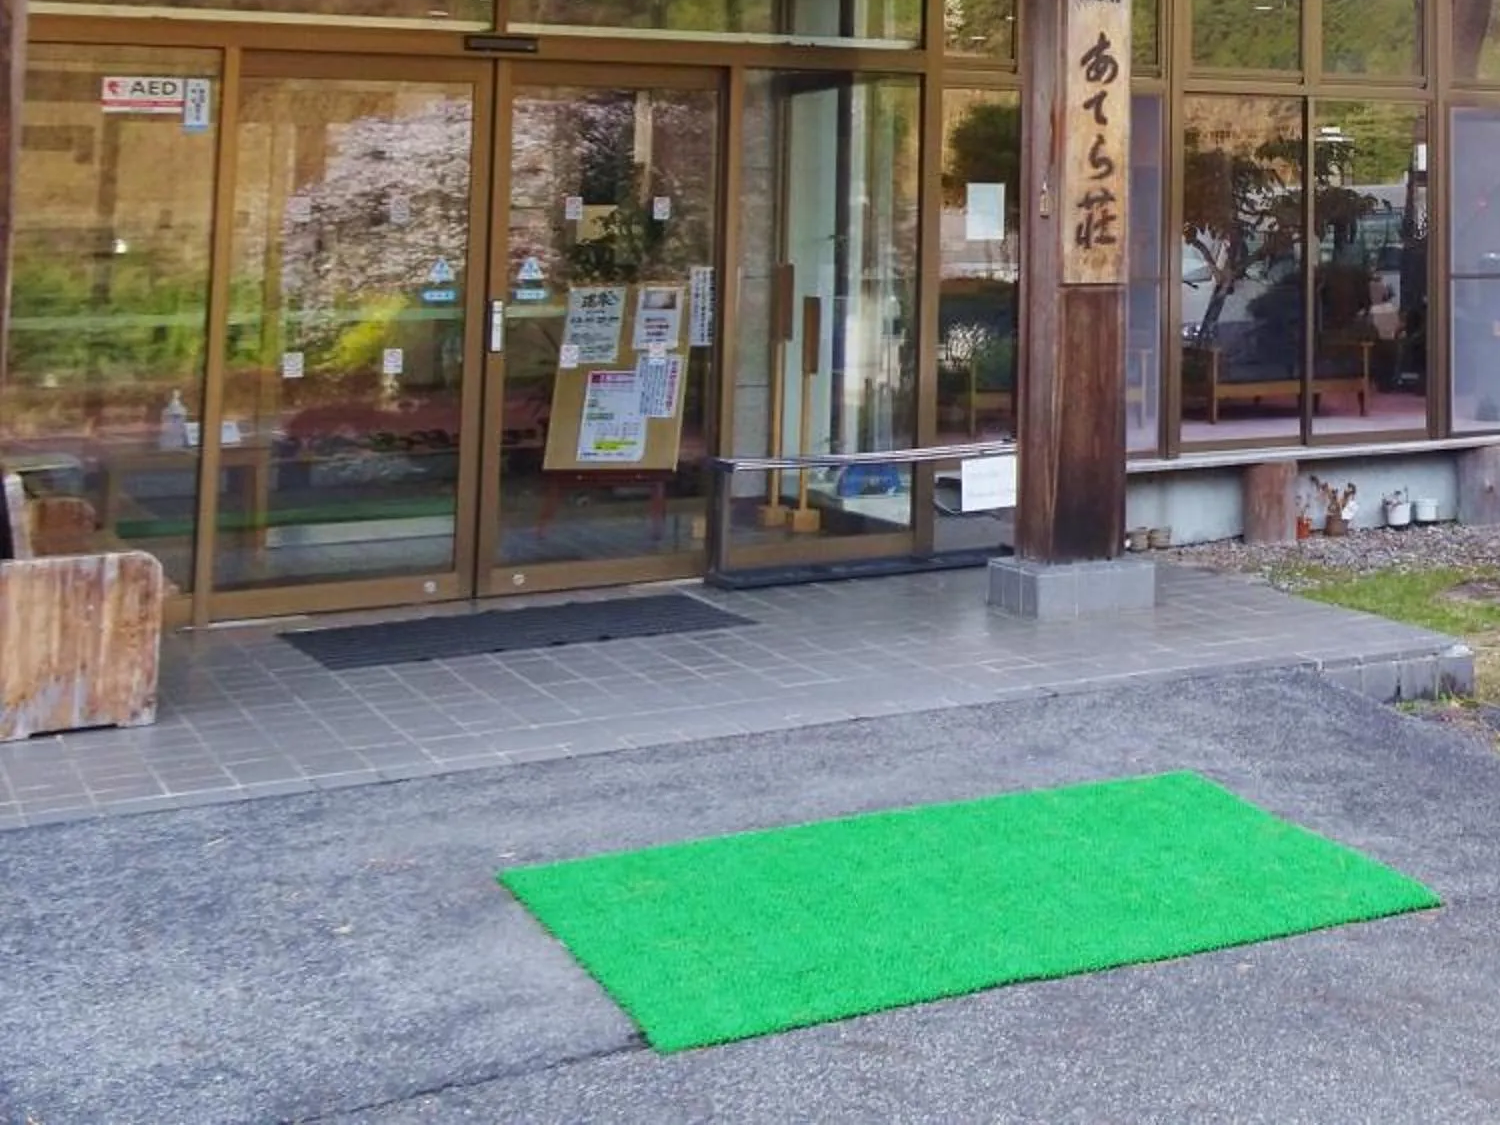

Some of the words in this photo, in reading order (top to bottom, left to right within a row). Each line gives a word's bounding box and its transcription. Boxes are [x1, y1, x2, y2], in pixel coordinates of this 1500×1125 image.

[129, 80, 178, 95] AED
[1075, 31, 1119, 249] あてら荘
